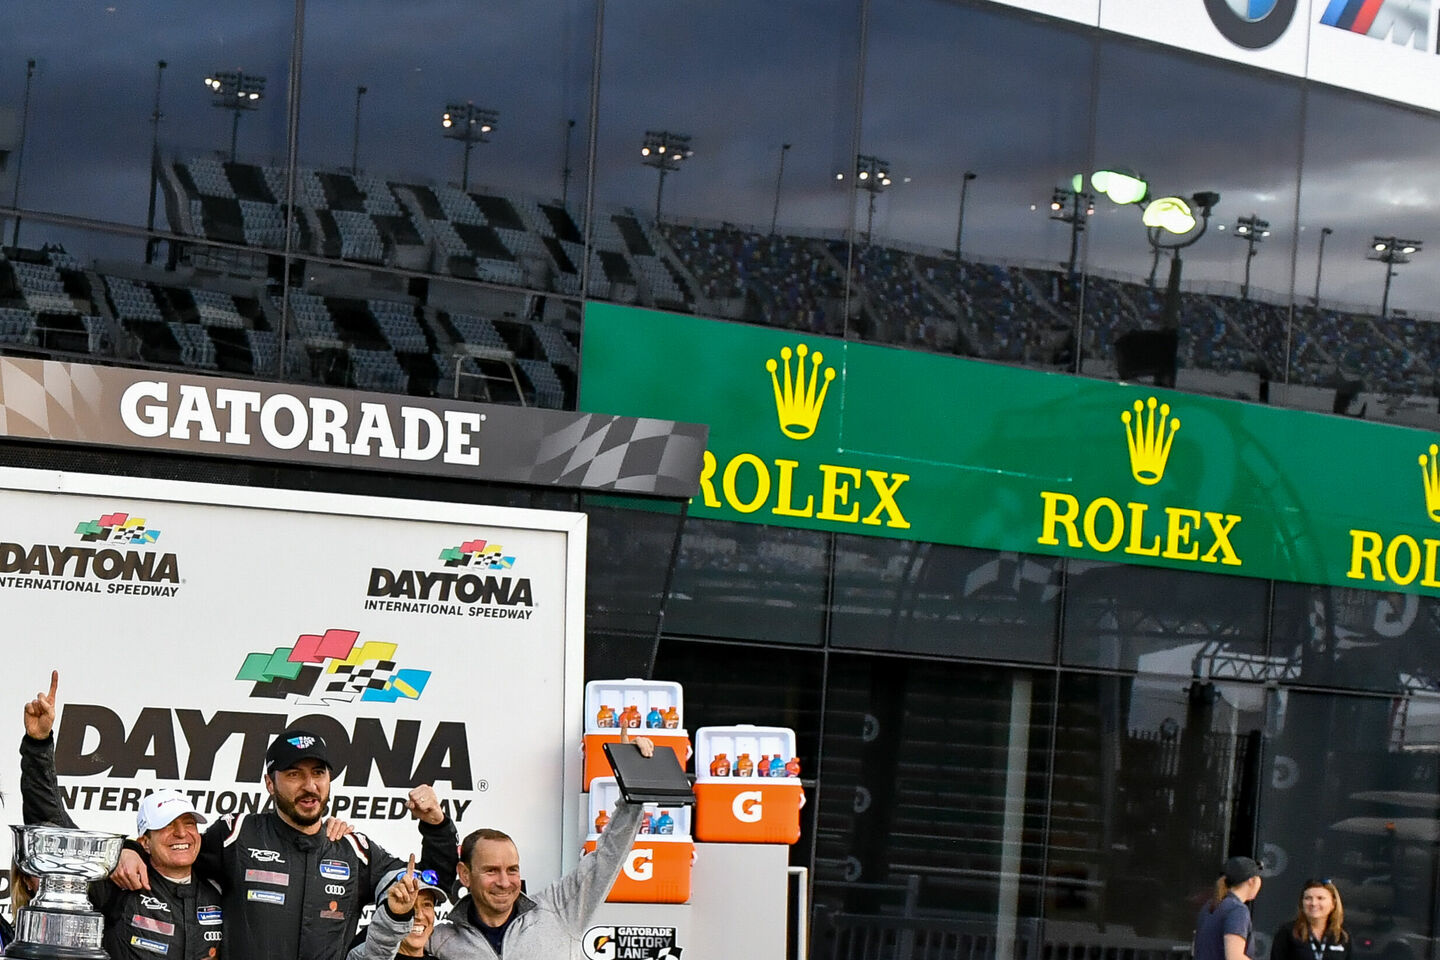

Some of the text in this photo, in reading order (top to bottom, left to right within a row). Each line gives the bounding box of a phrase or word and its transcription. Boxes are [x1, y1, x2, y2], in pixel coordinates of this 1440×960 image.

[121, 381, 479, 466] GATORADE
[1038, 491, 1242, 566] ROLEX
[107, 582, 179, 597] SPEEDWAY
[367, 567, 533, 606] DAYTONA
[364, 600, 532, 619] INTERNATIONAL SPEEDWAY
[732, 791, 762, 822] G
[623, 849, 653, 881] G
[617, 927, 672, 937] GATORADE
[618, 936, 672, 948] VICTORY
[617, 947, 649, 959] LANE
